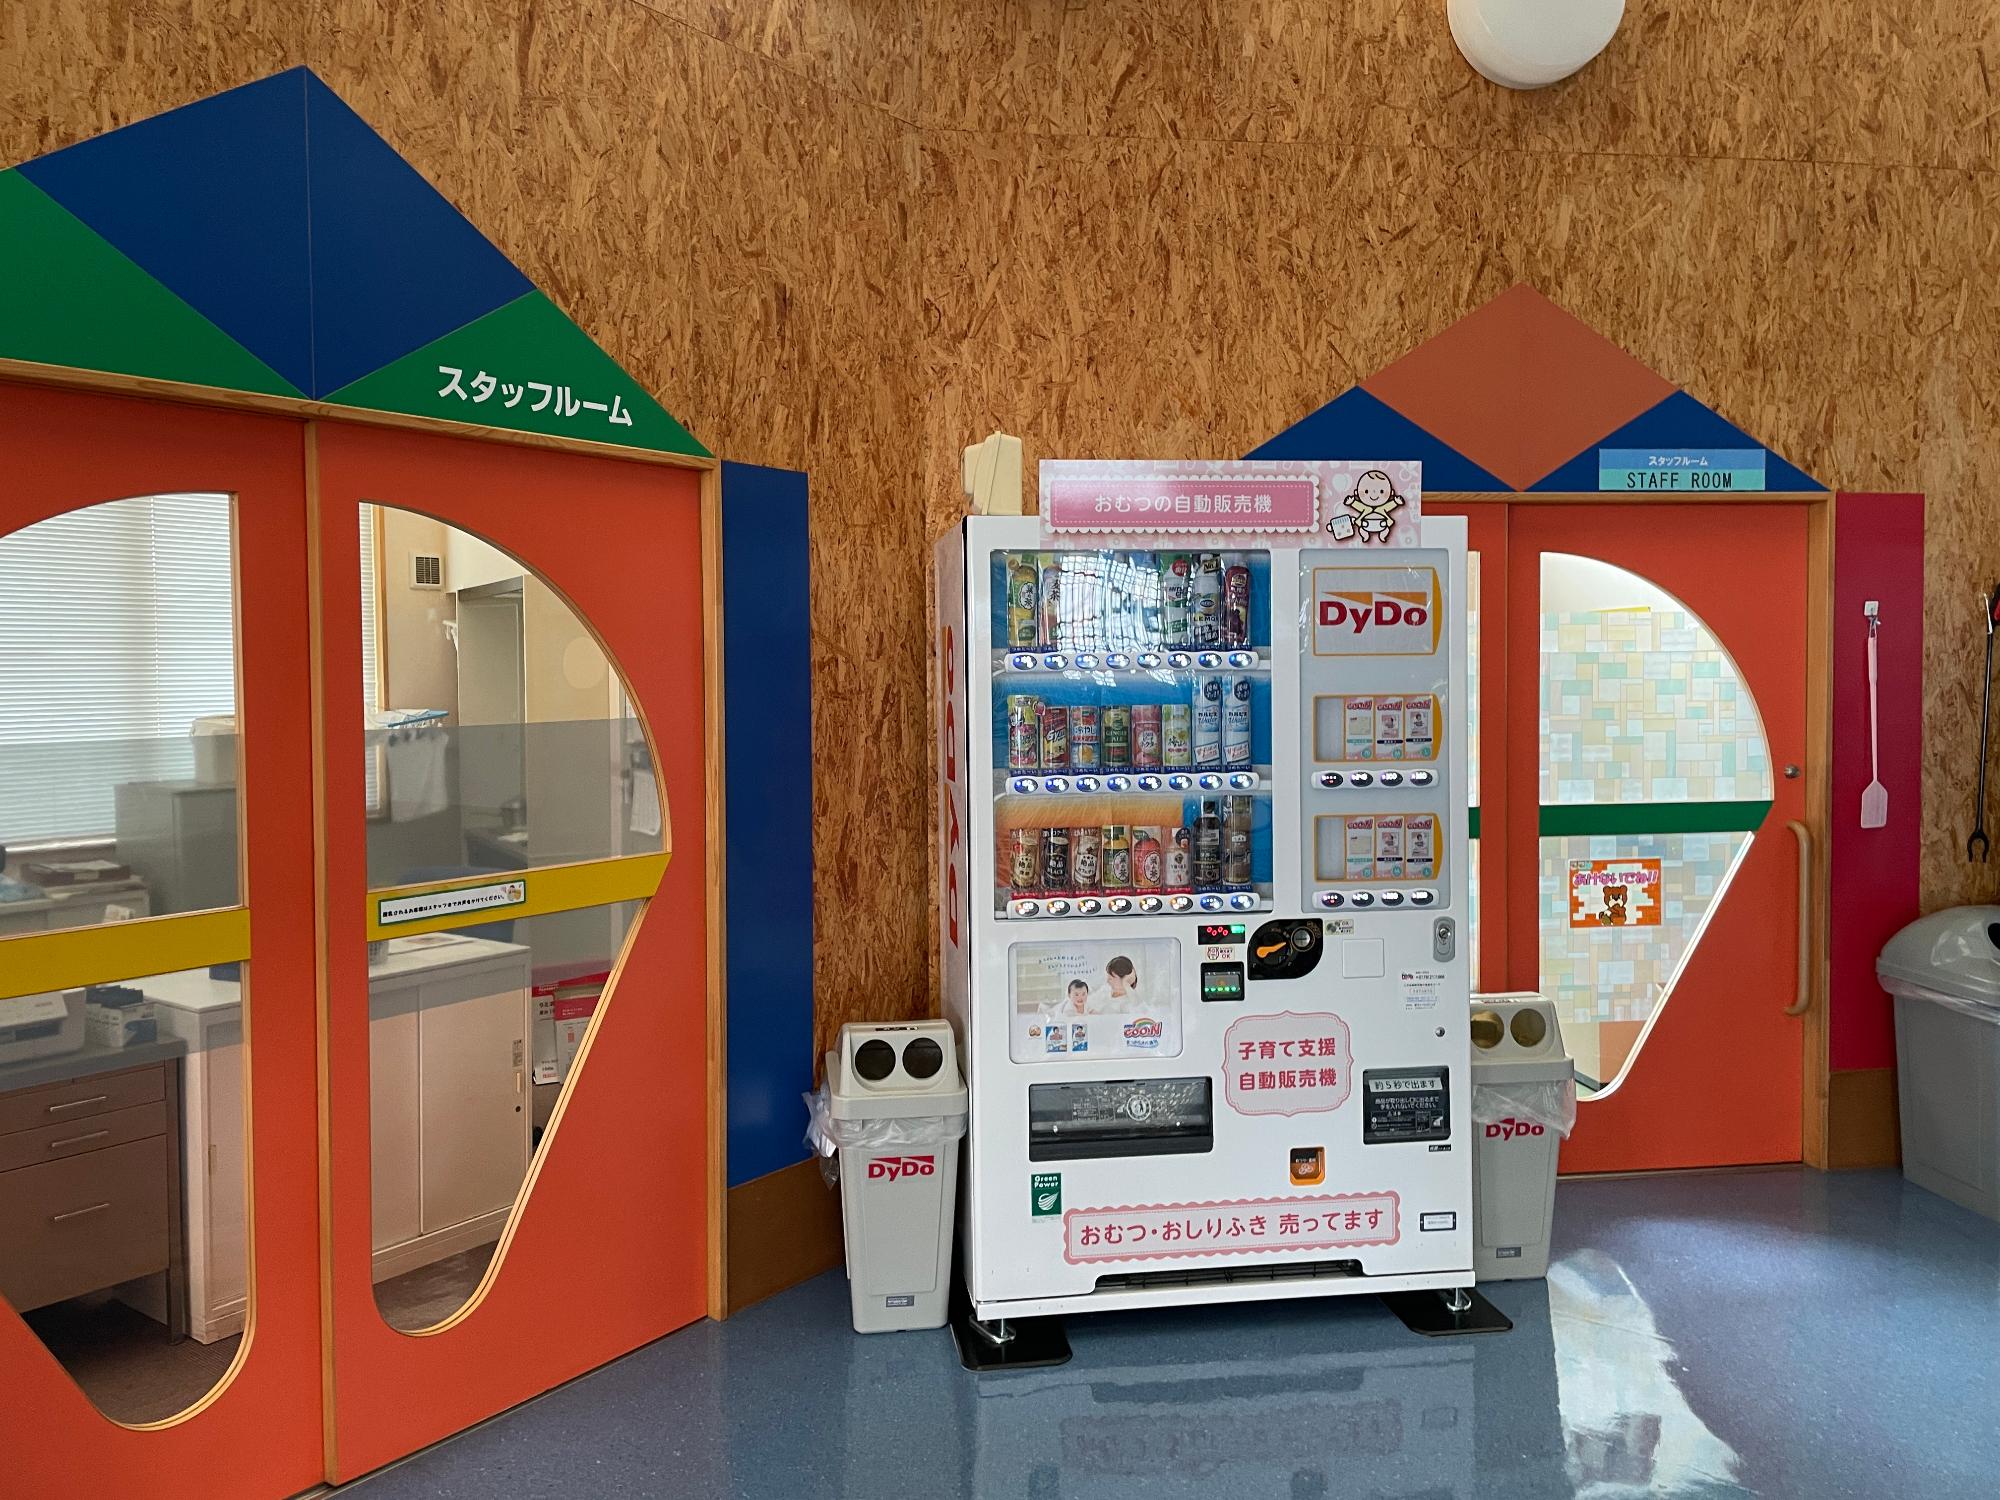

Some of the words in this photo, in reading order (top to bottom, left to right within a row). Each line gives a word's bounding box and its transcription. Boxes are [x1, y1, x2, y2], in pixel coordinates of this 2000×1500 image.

[438, 366, 632, 426] スタッフルーム
[1649, 456, 1708, 466] スタッフルーム
[1627, 472, 1679, 488] STAFF
[1691, 472, 1732, 488] ROOM
[1095, 494, 1272, 514] おむつの自動販売機
[1320, 601, 1427, 634] DyDo
[1238, 1037, 1336, 1060] 子育て支援
[1239, 1067, 1337, 1091] 自動販売機
[1486, 1121, 1544, 1141] DyDo
[867, 1161, 935, 1182] DyDo
[1080, 1214, 1268, 1247] おむつ・おしりふき
[1279, 1207, 1384, 1234] 売ってます
